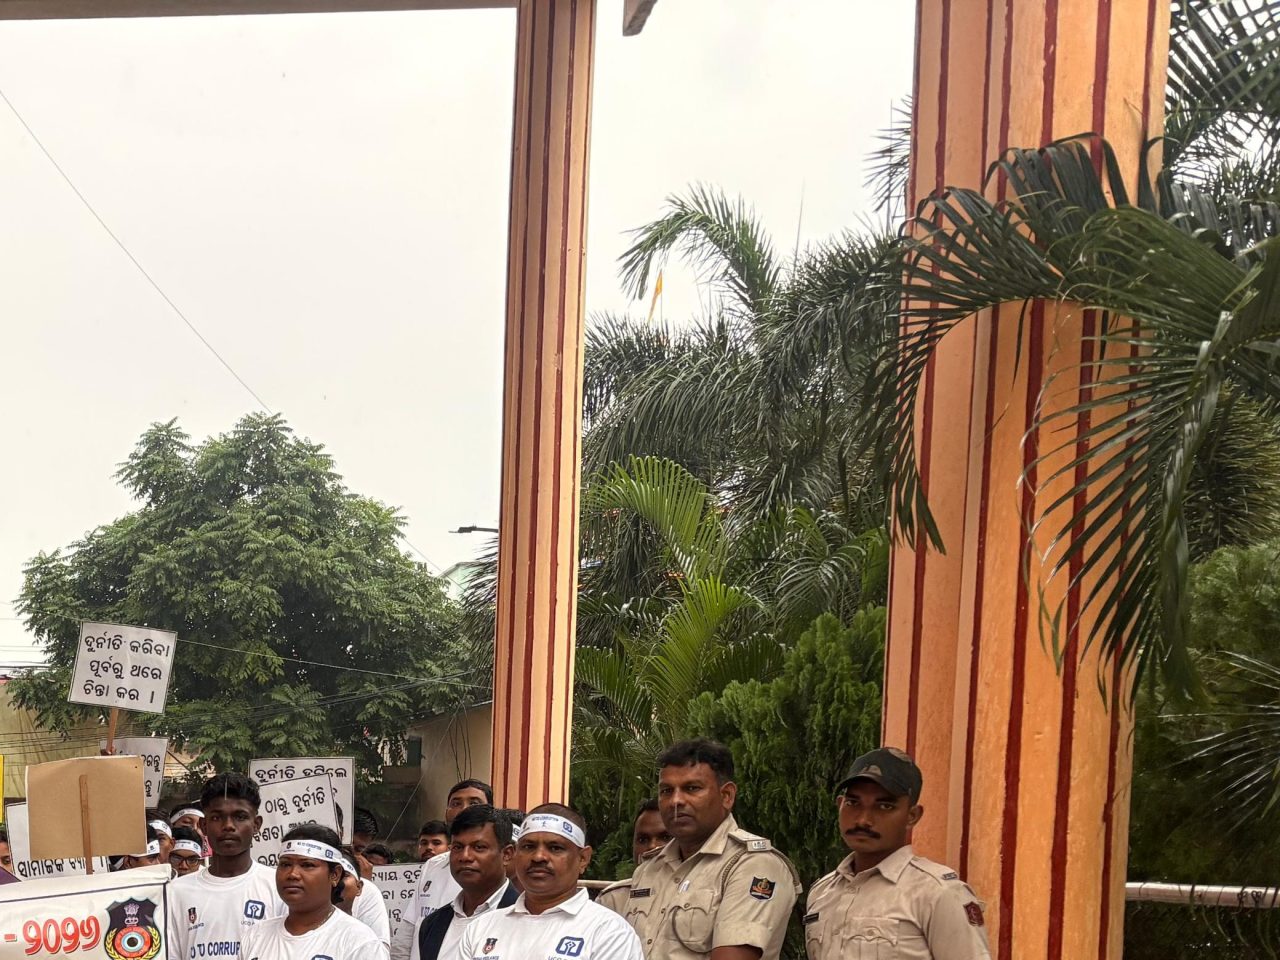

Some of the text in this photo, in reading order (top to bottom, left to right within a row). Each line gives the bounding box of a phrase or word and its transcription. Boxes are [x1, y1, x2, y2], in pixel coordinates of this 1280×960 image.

[84, 631, 170, 657] ଦୁର୍ନୀତି କରିବା
[89, 655, 162, 680] ପୂର୍ବରୁ ଥରେ
[83, 679, 110, 697] ଚିନ୍ତା
[116, 686, 139, 701] କର
[264, 786, 326, 816] ଠାରୁ ଦୁର୍ନୀତି
[207, 941, 241, 957] CORRUP
